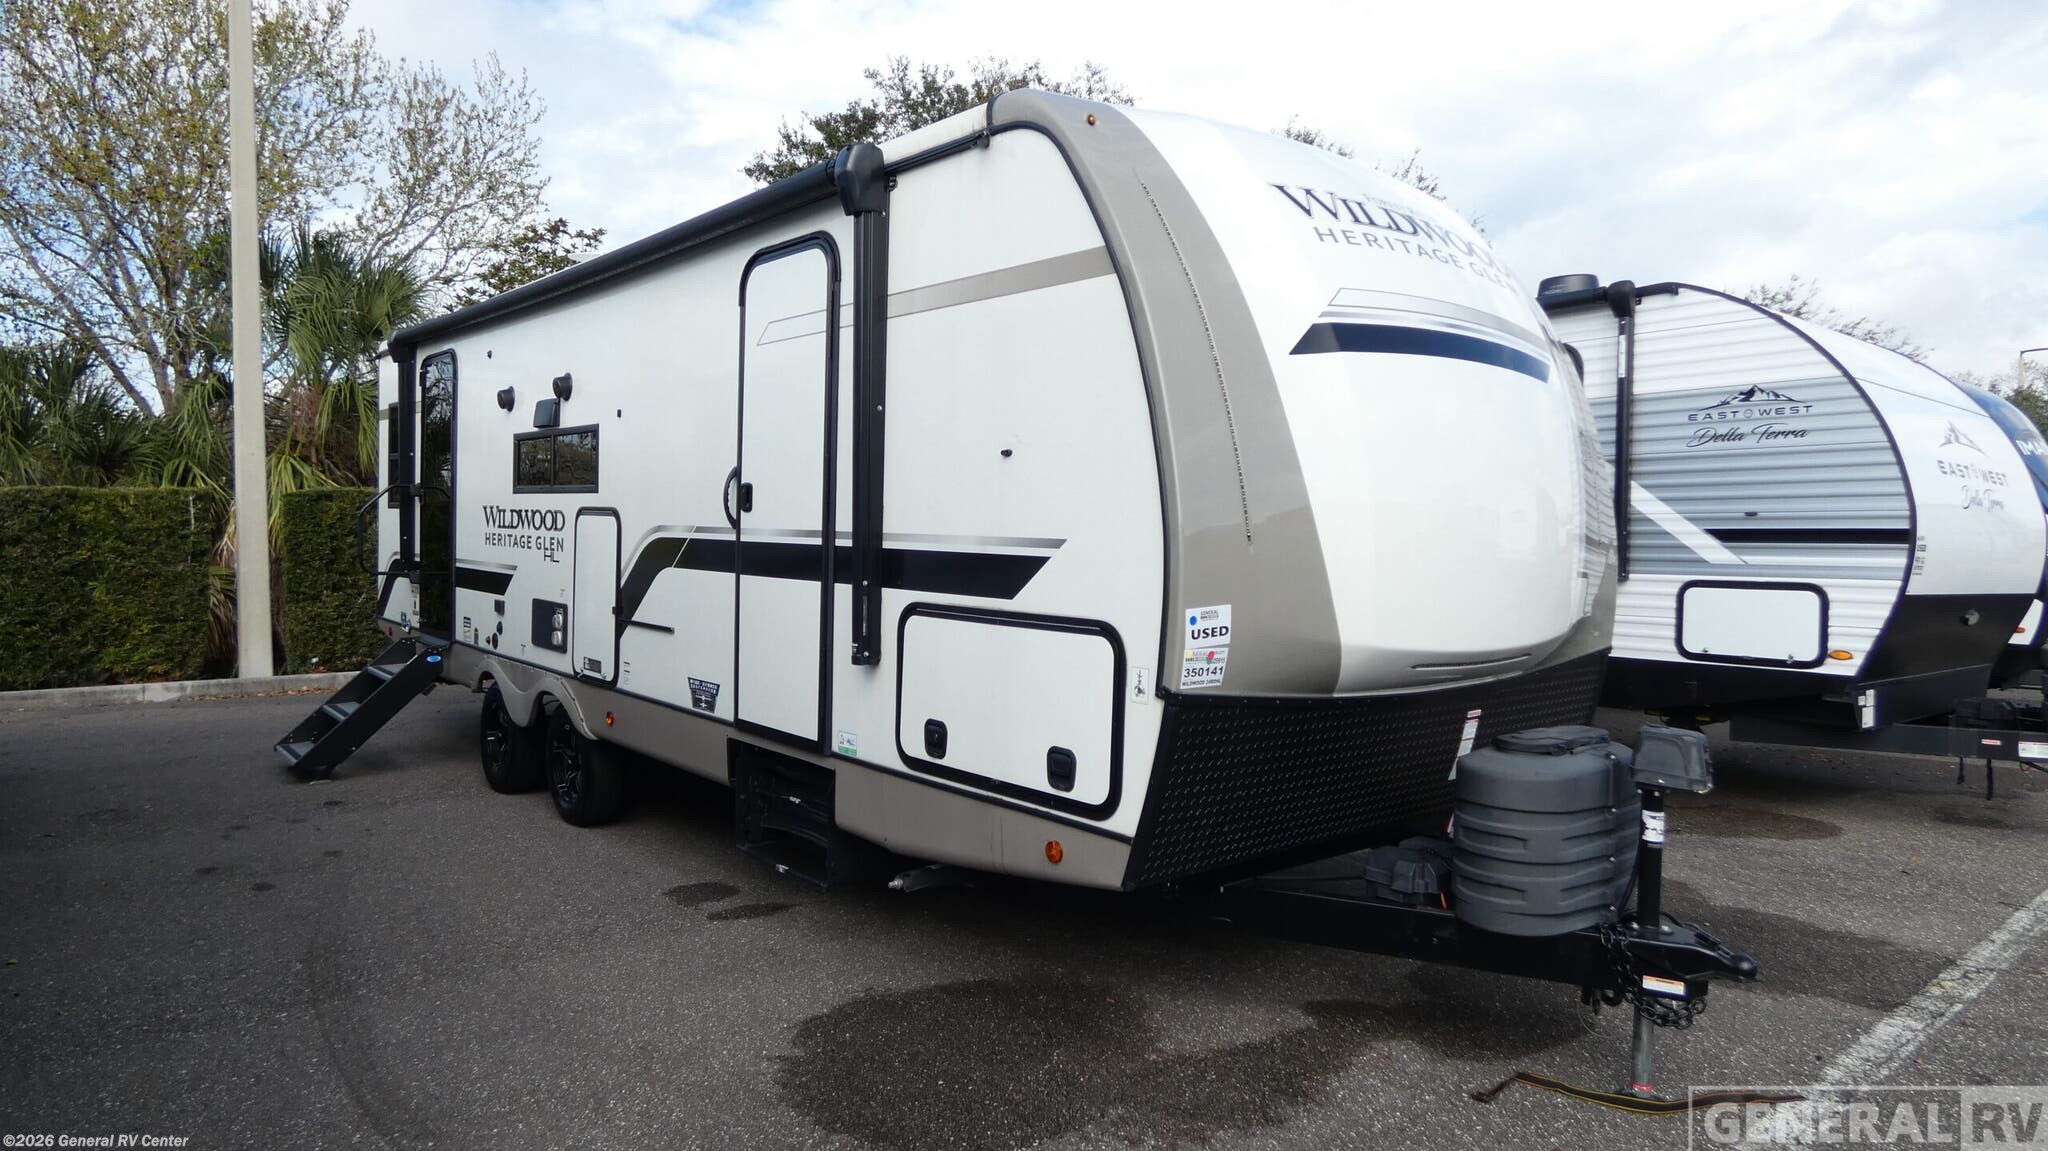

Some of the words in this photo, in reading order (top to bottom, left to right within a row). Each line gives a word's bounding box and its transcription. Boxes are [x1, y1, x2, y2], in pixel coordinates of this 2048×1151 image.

[1313, 226, 1465, 271] HERITAGE
[1688, 410, 1739, 422] EAST
[1758, 405, 1813, 417] WEST
[1686, 427, 1745, 447] Della
[1751, 423, 1808, 443] Terra
[482, 505, 566, 531] WILDWOOD
[485, 532, 532, 549] HERITAGE
[535, 535, 564, 552] GLEN
[543, 550, 560, 563] HL
[1191, 625, 1229, 640] USED
[1183, 666, 1224, 678] 350141
